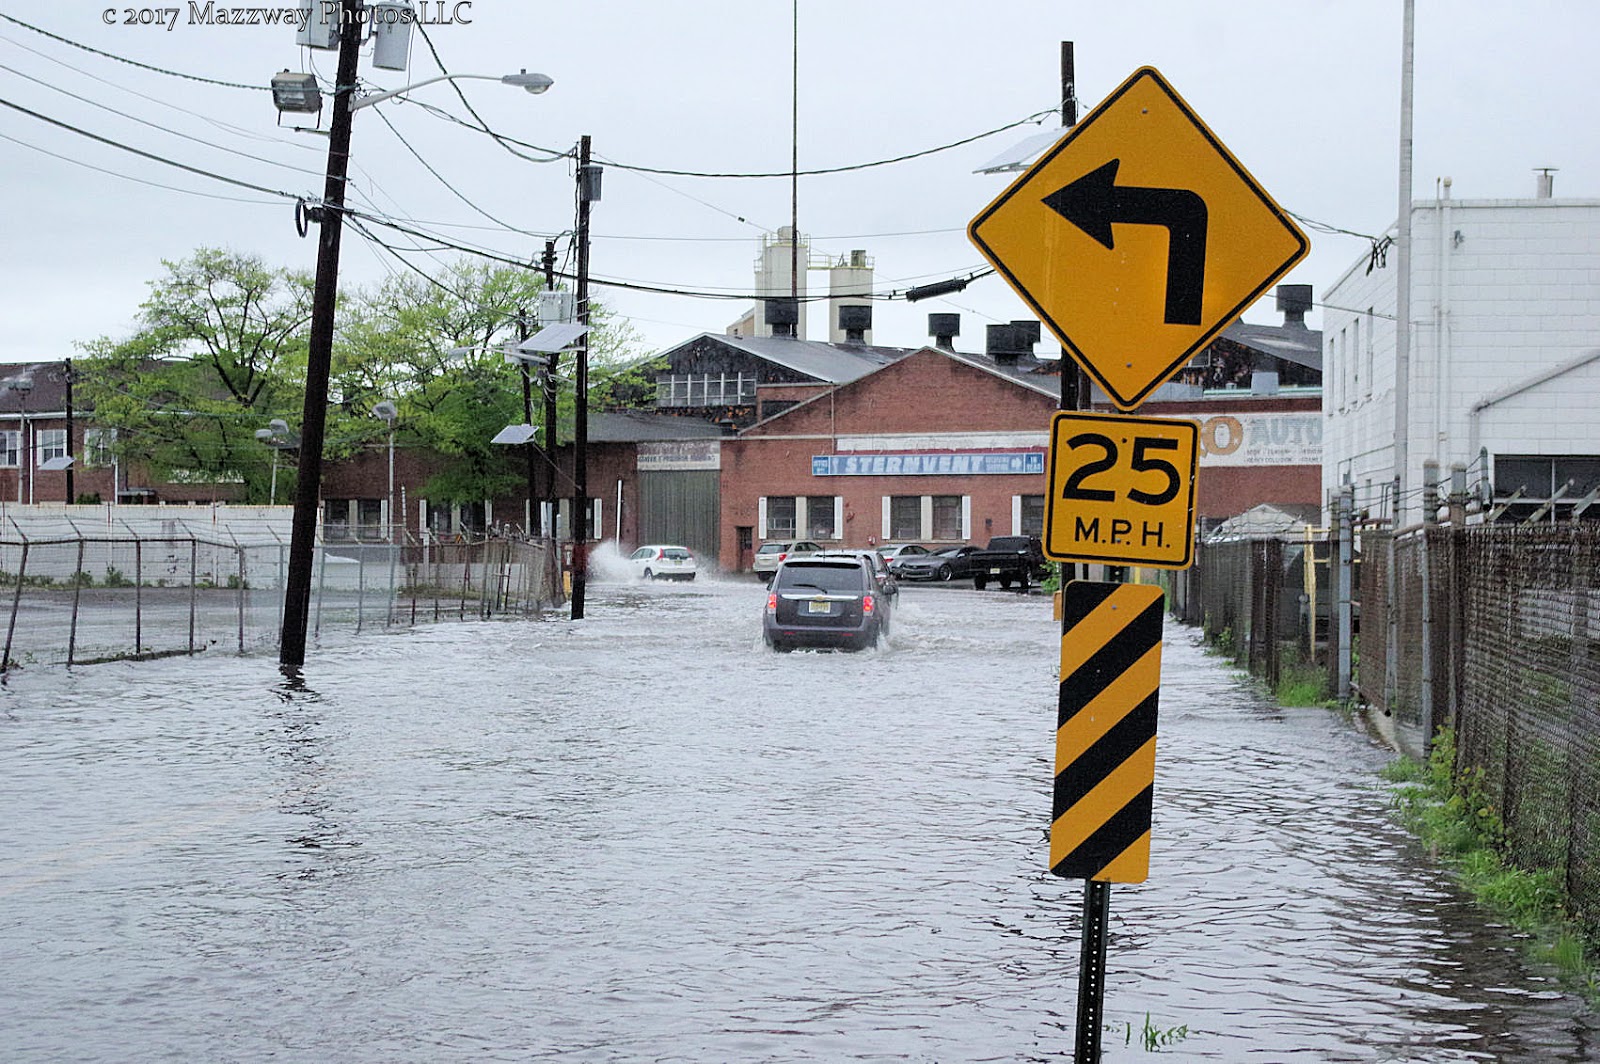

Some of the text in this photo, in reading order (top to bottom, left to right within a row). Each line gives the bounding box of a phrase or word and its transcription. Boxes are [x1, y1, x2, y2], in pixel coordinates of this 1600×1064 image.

[1200, 416, 1323, 456] O AUTO
[844, 455, 984, 474] STERNVENT
[1062, 433, 1181, 506] 25
[1074, 516, 1171, 548] M.P.H.
